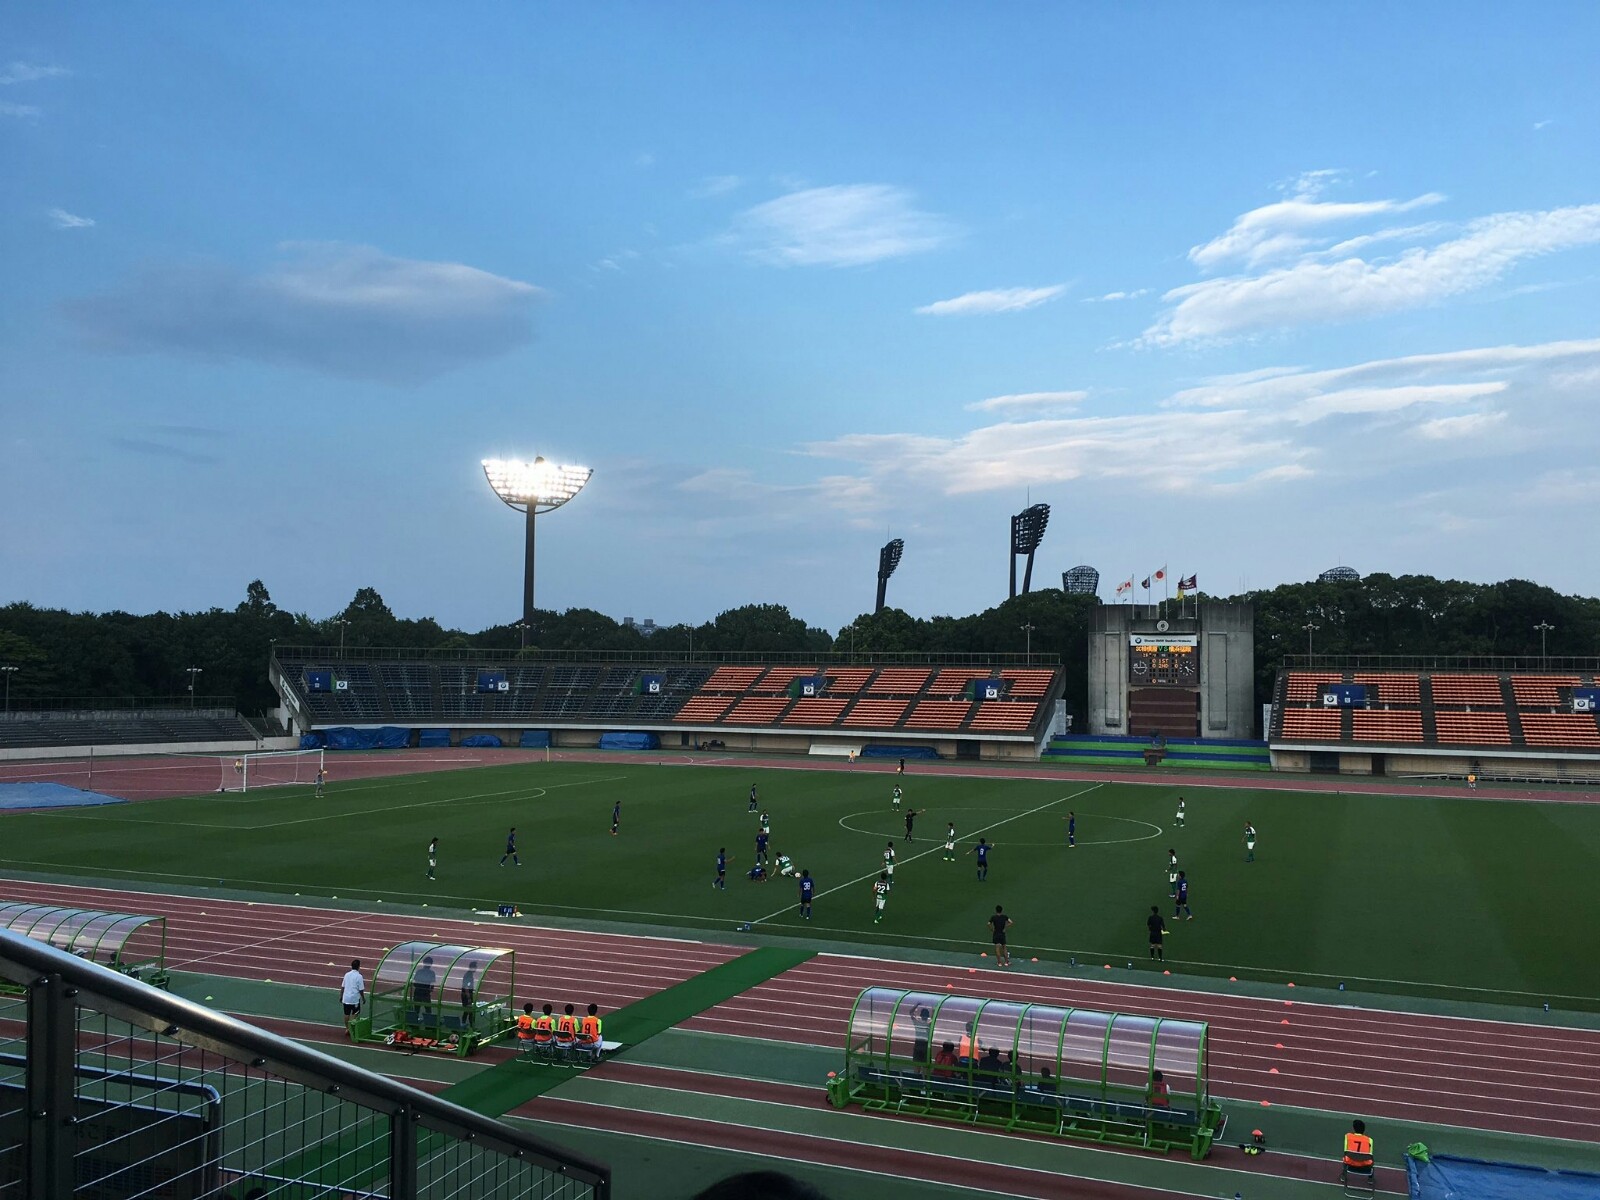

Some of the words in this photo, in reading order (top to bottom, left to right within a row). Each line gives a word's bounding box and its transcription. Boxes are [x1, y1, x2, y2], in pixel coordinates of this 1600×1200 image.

[878, 885, 886, 893] 22
[585, 1023, 591, 1034] 9
[1354, 1141, 1361, 1152] 7
